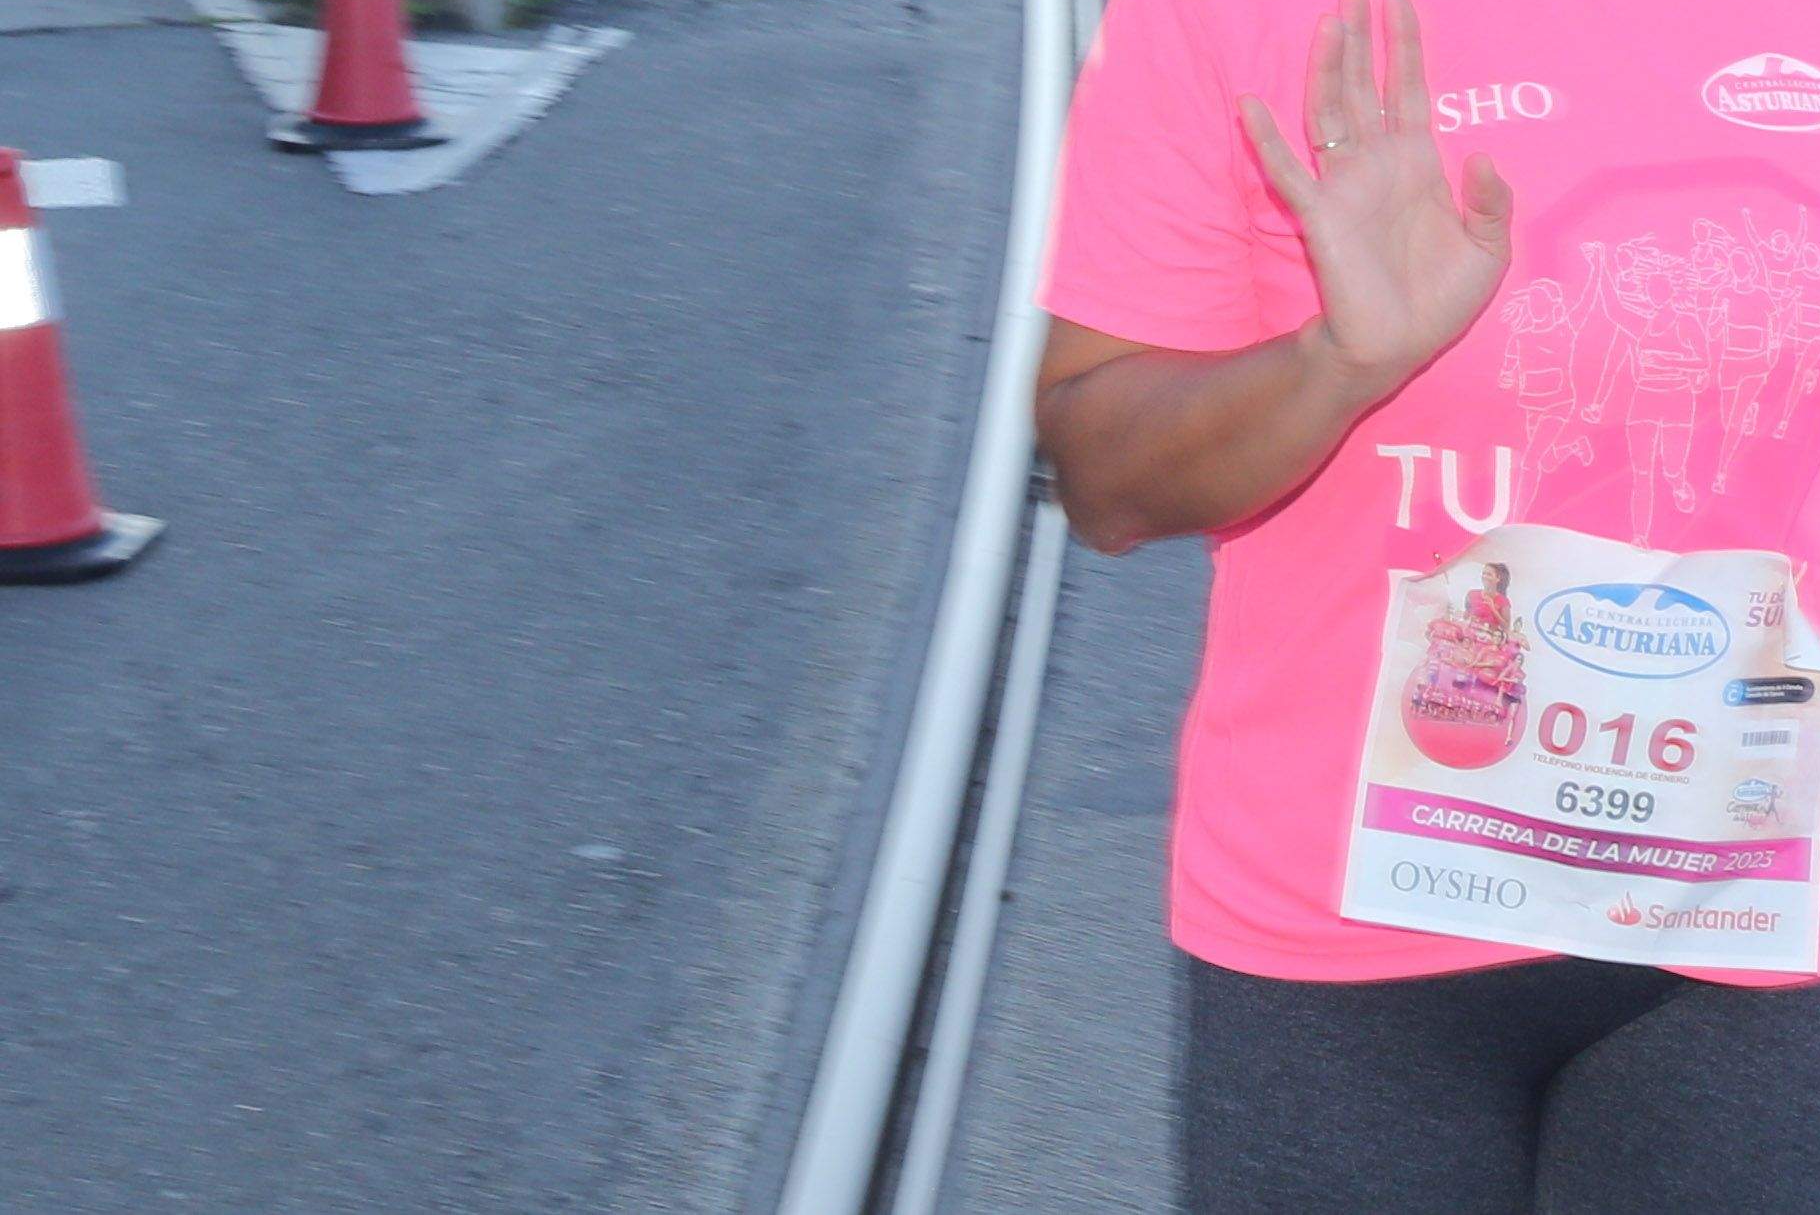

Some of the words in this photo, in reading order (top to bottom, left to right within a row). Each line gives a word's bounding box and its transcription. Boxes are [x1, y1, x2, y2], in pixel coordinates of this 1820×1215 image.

[1436, 81, 1553, 132] SHO
[1376, 443, 1511, 535] TU
[1548, 602, 1717, 656] ASTURIANA
[1586, 606, 1650, 626] CENTRAL
[1538, 701, 1698, 773] 016
[1555, 781, 1655, 824] 6399
[1411, 804, 1536, 848] CARRERA
[1542, 836, 1579, 857] DE
[1586, 840, 1621, 862] LA
[1627, 846, 1717, 872] MUJER
[1724, 850, 1775, 872] 2023
[1390, 859, 1528, 910] OYSHO
[1645, 904, 1781, 934] Santander
